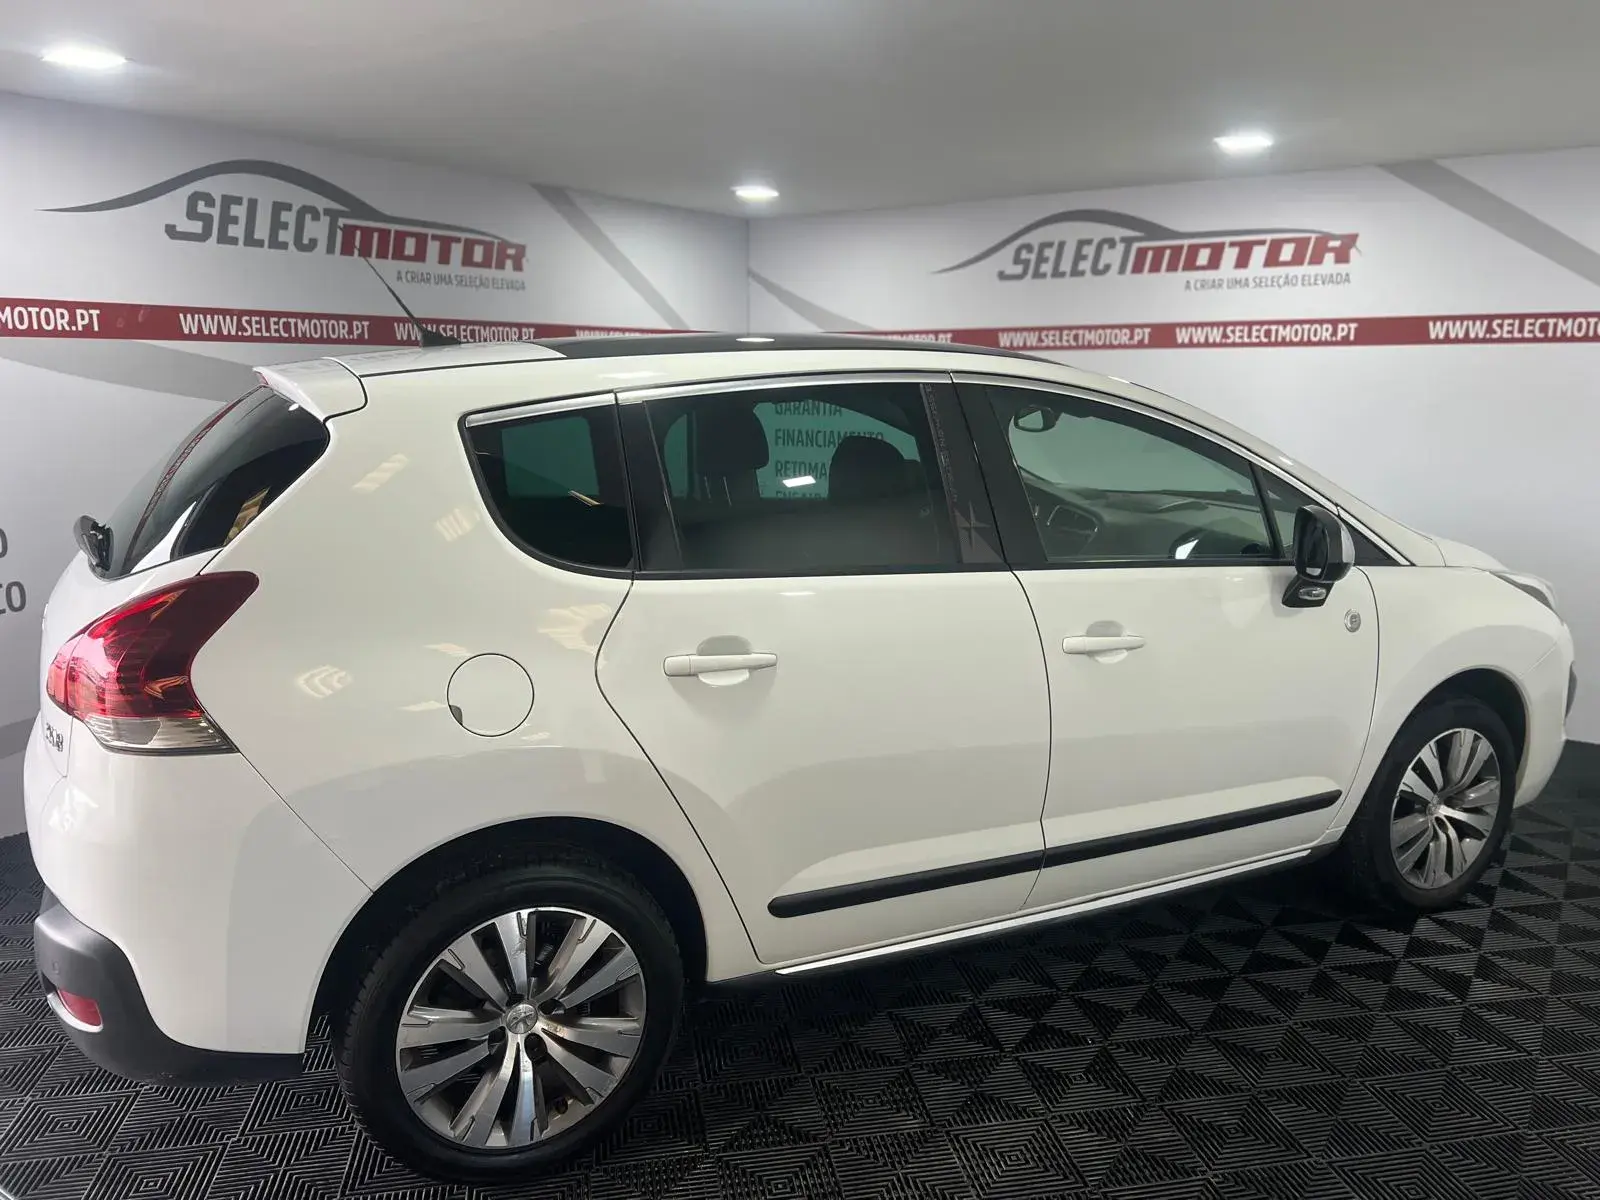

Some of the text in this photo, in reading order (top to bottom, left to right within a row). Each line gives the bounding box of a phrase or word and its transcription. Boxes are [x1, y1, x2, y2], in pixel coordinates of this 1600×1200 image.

[396, 270, 403, 282] A
[405, 271, 432, 286] CRIAR
[434, 273, 454, 287] UMA
[492, 278, 526, 291] ELEVADA
[1184, 272, 1351, 291] A CRIAR UMA SELEÇÃO ELEVADA
[178, 313, 369, 339] WWW.SELECTMOTOR.PT
[1175, 323, 1358, 344] WWW.SELECTMOTOR.PT
[1428, 317, 1600, 340] WWW.SELECTMOT
[998, 328, 1151, 348] WWW.SELECTMOTOR.PT
